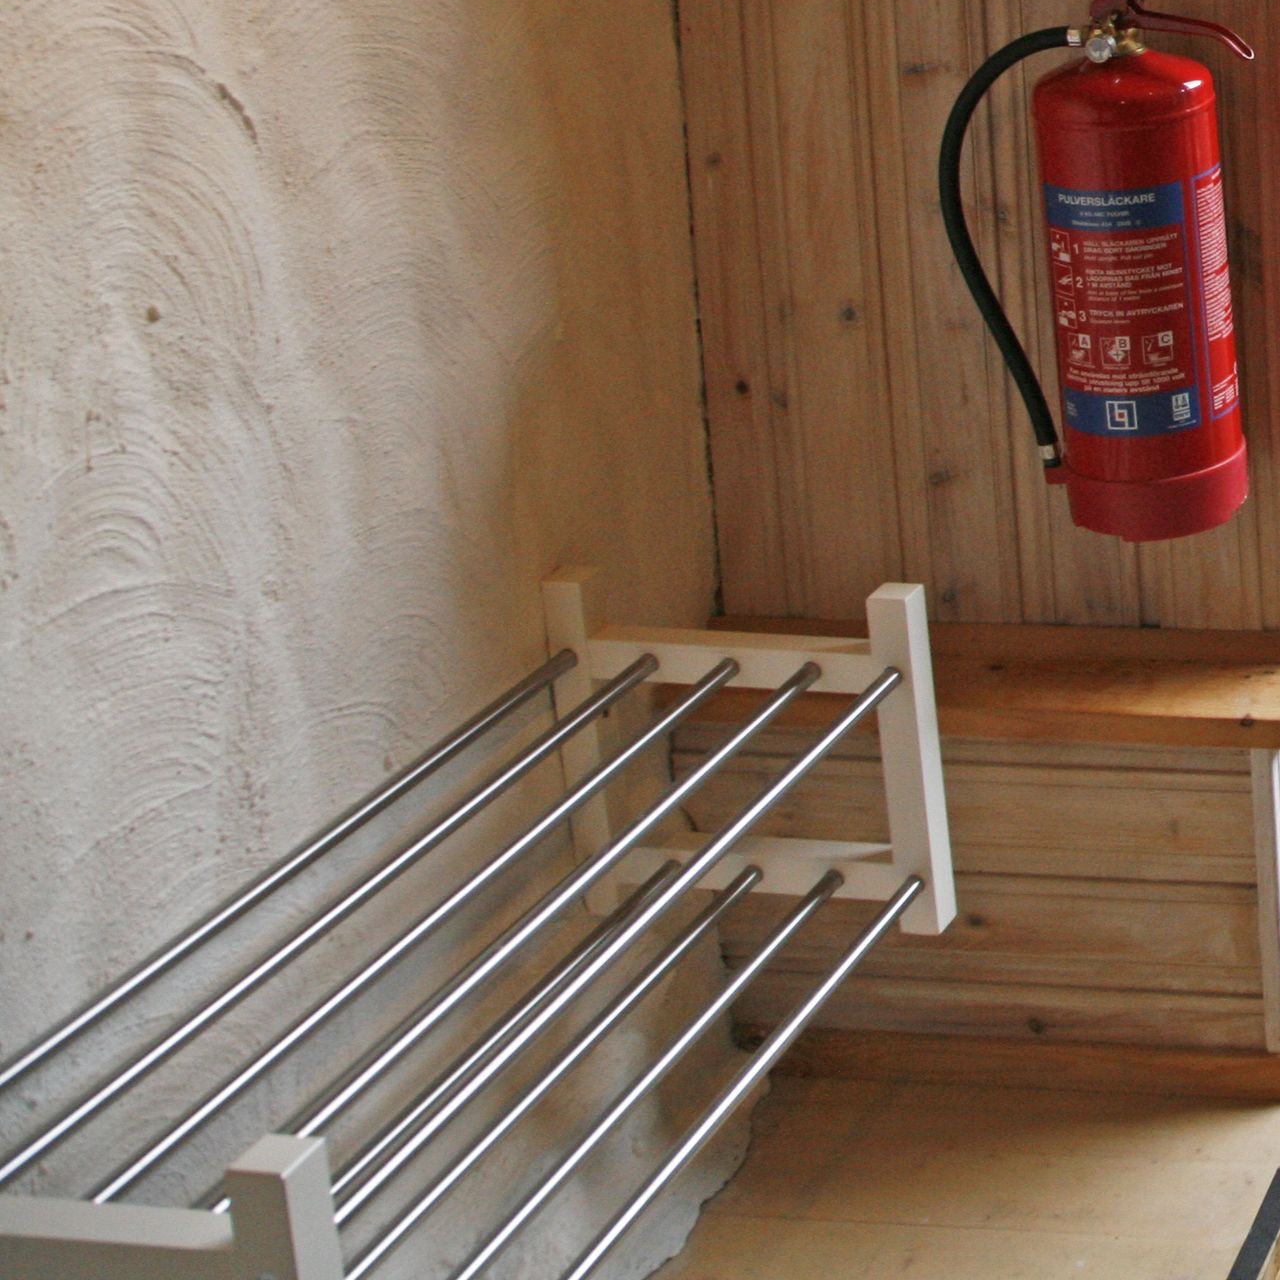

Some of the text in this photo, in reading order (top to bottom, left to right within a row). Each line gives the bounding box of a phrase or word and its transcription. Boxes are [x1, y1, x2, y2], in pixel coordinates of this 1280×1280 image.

[1058, 192, 1156, 207] PULVERSLÄCKARE
[1073, 243, 1079, 255] 1
[1075, 276, 1084, 289] 2
[1079, 310, 1087, 322] 3
[1081, 337, 1088, 347] A
[1119, 338, 1127, 348] B
[1161, 333, 1170, 344] C
